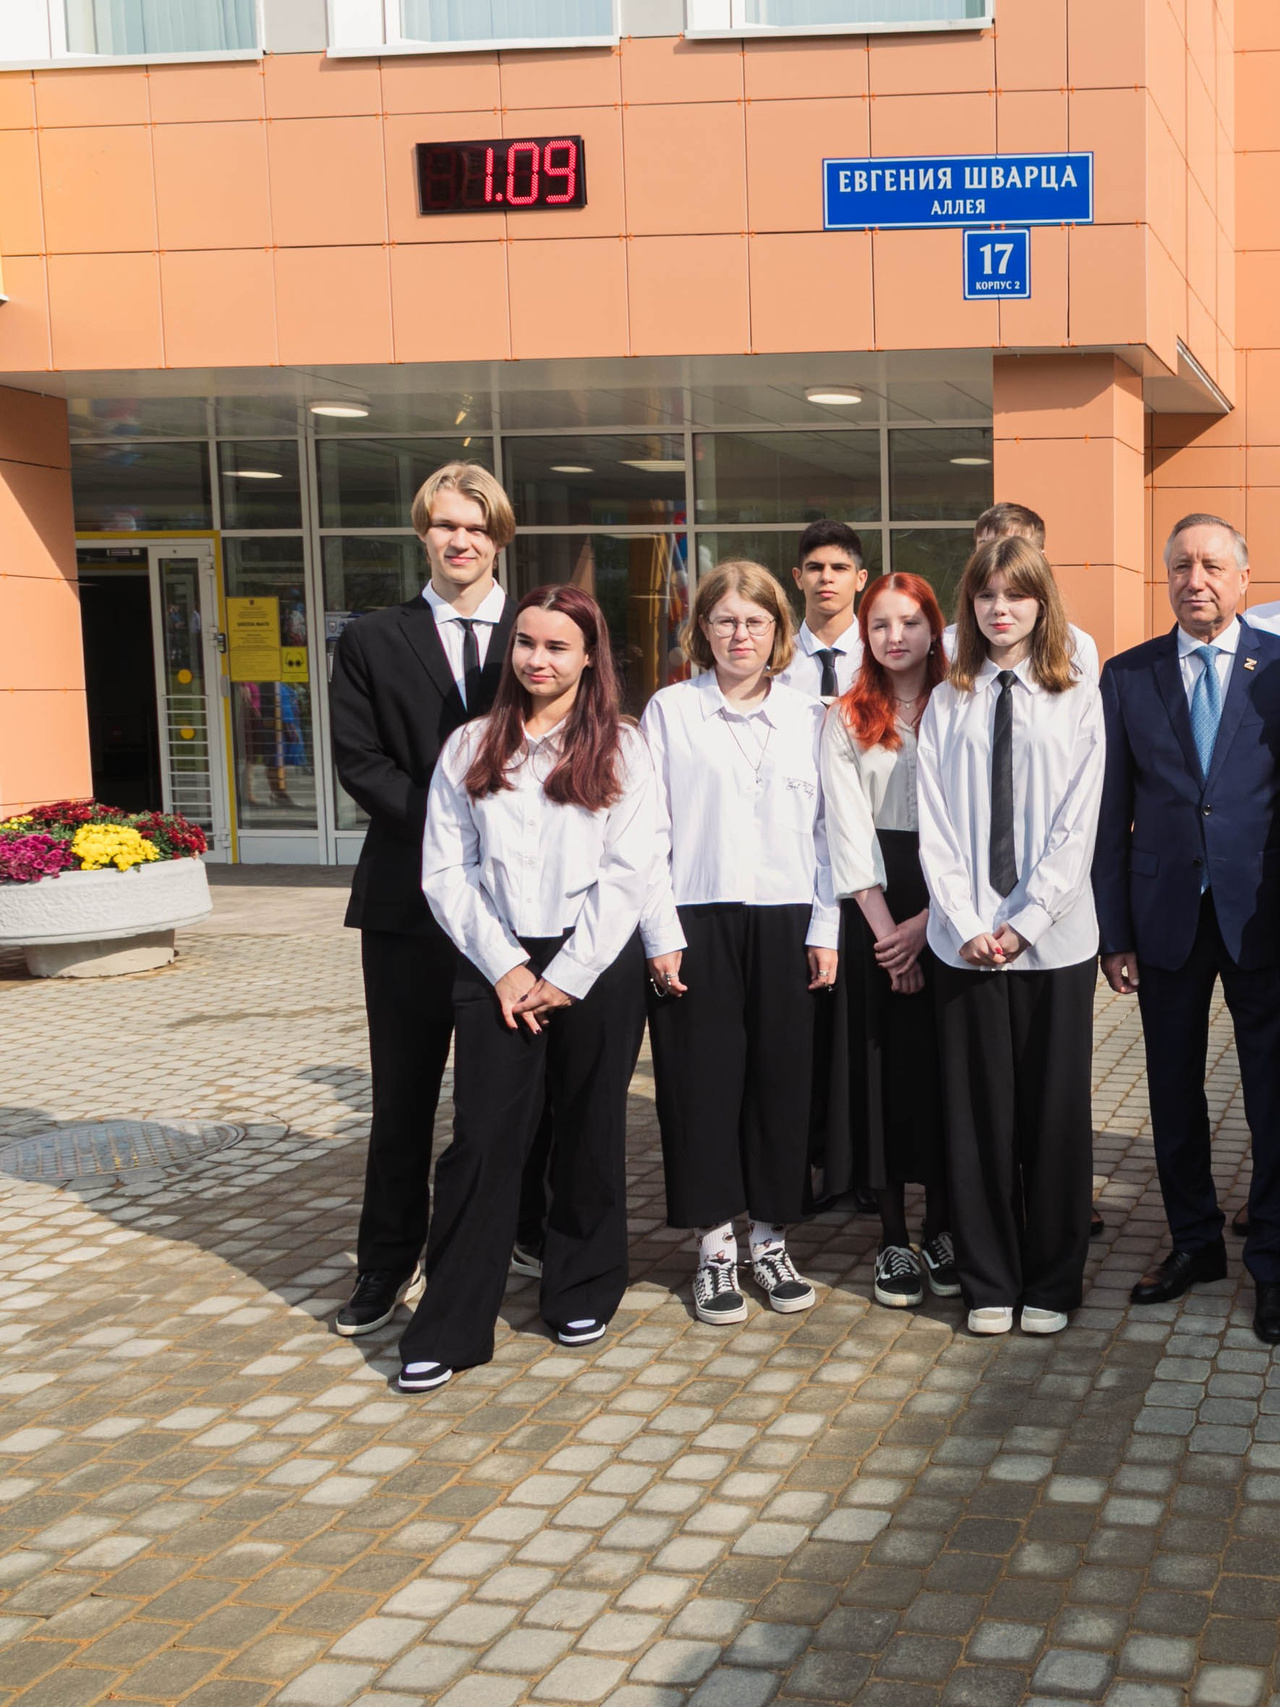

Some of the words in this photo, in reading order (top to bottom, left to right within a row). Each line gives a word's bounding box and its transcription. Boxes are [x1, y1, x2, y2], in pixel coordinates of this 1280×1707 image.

[484, 140, 577, 206] 1.09
[838, 167, 952, 193] ЕВГЕНИЯ
[964, 164, 1078, 191] ШВАРЦА
[931, 198, 986, 215] АЛЛЕЯ
[979, 243, 1014, 275] 17
[975, 280, 1013, 290] КОРПУС
[1014, 280, 1020, 290] 2
